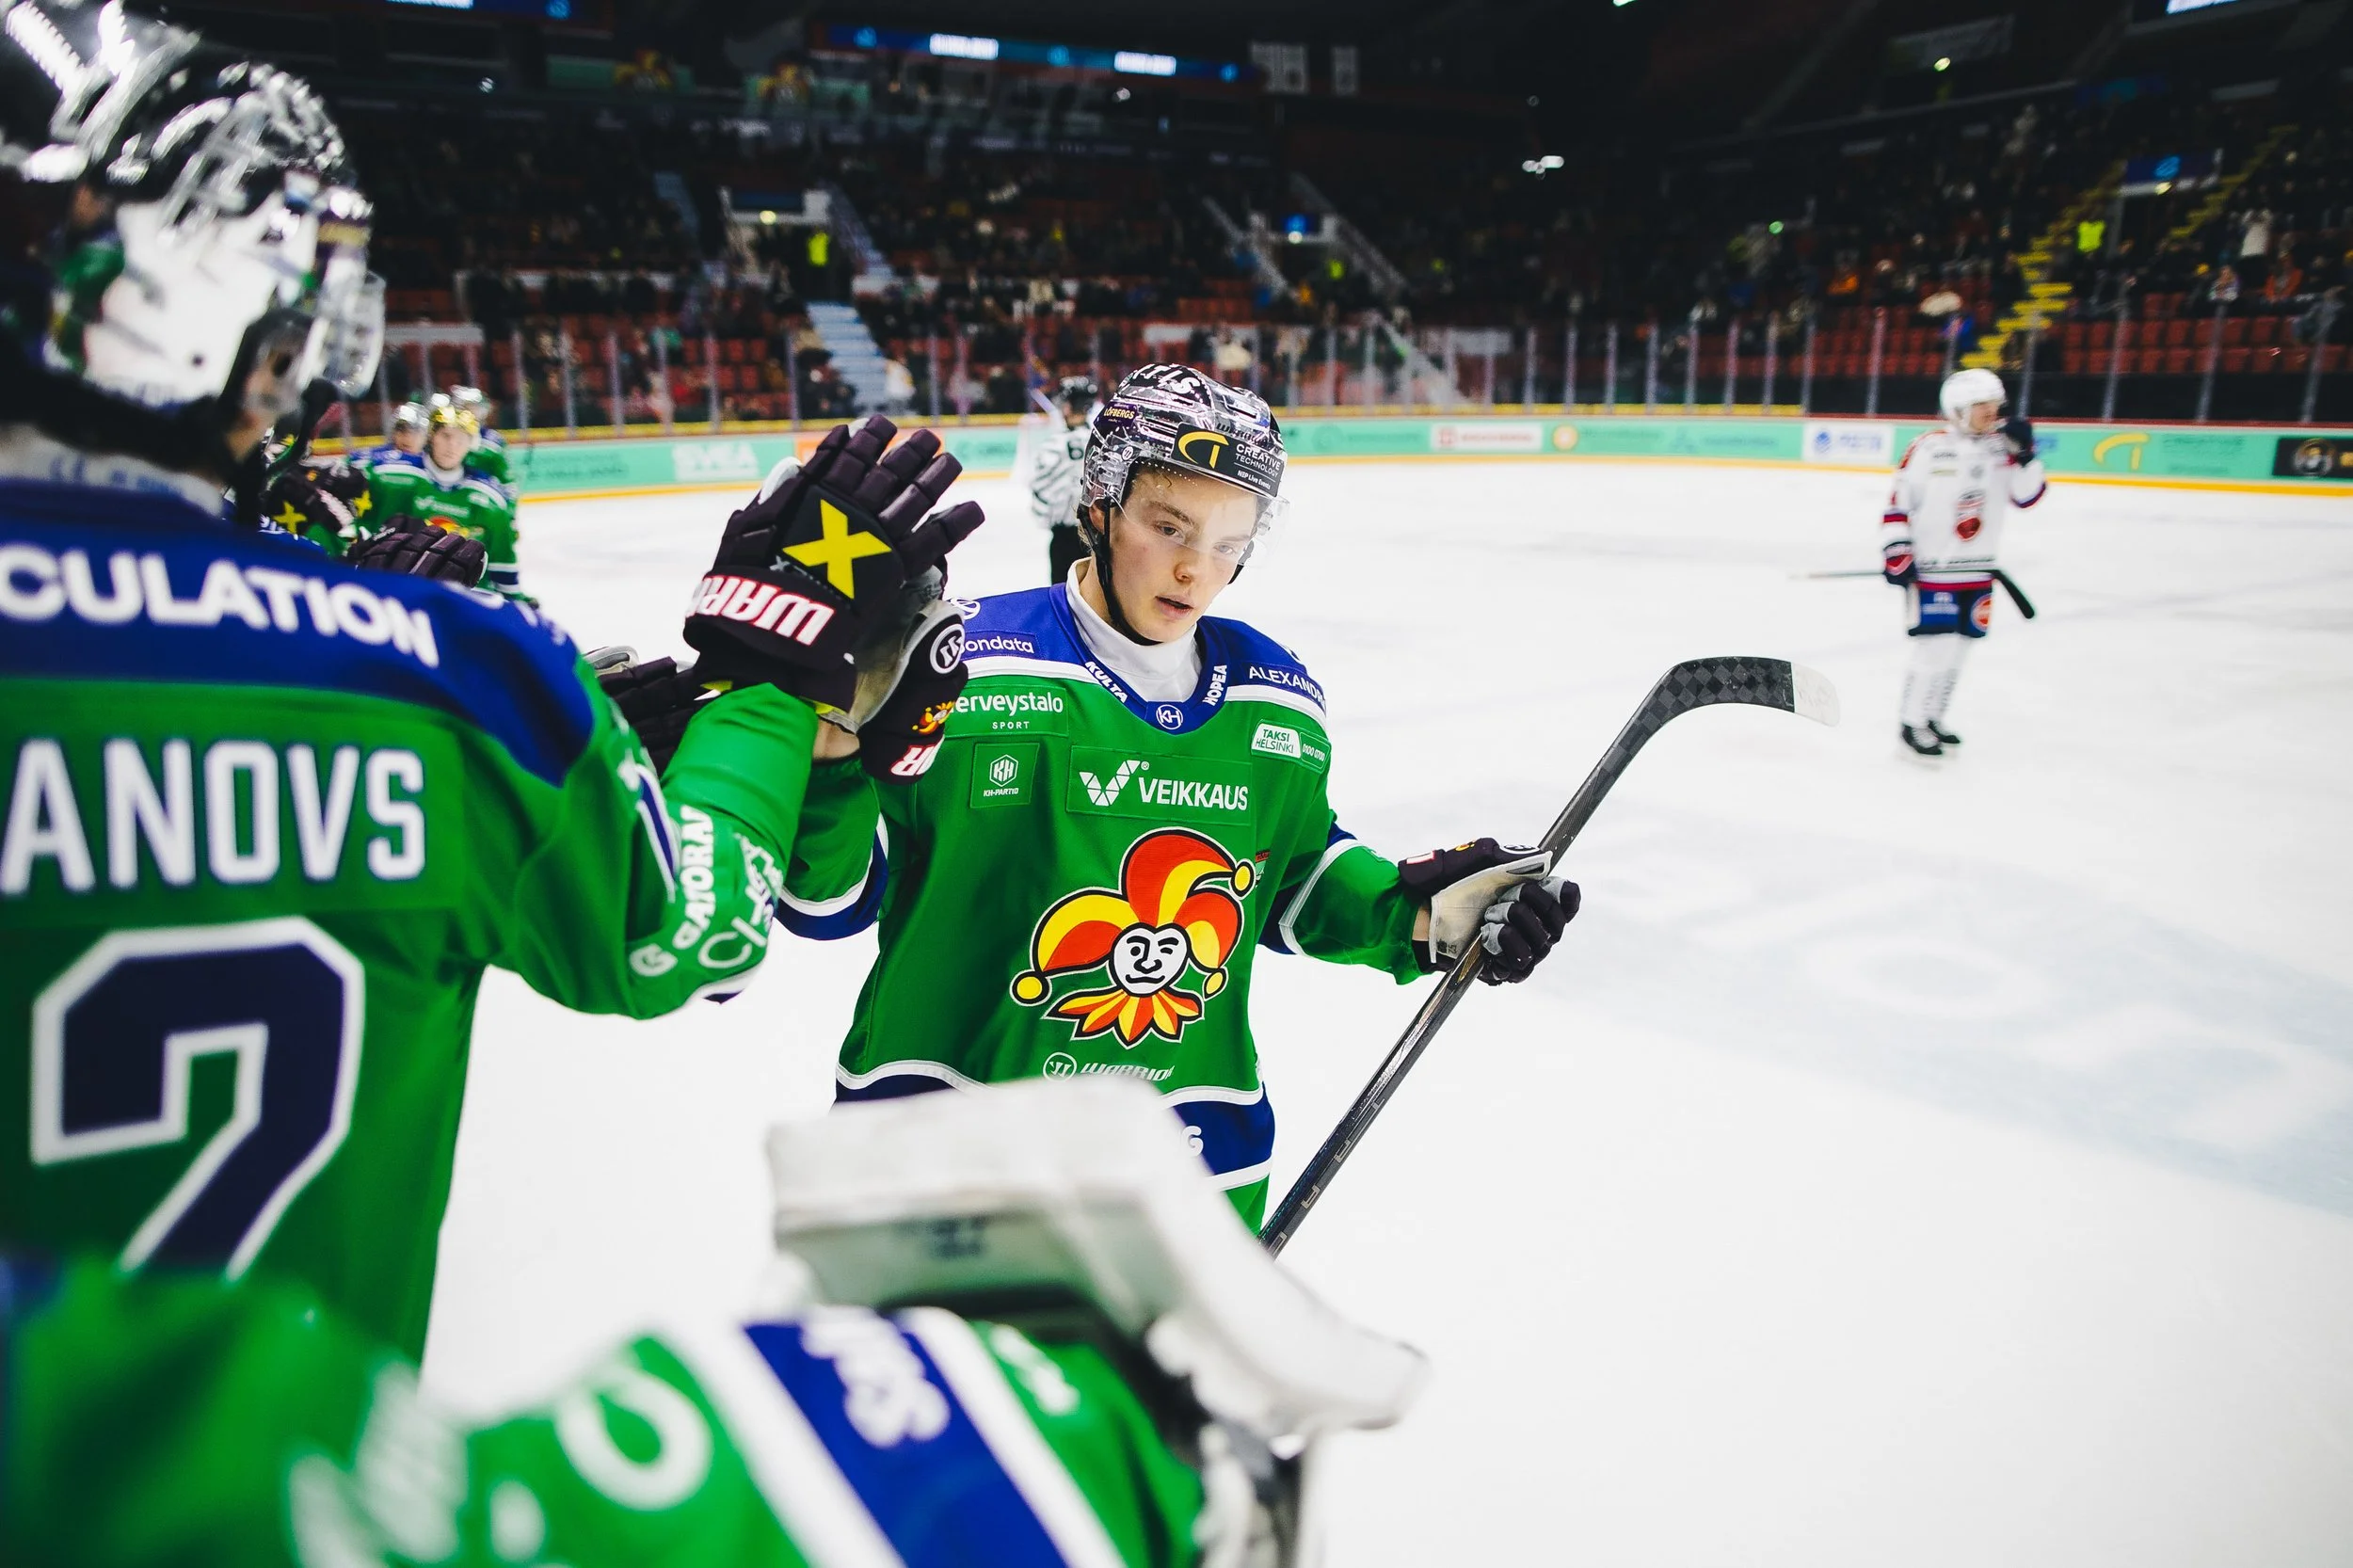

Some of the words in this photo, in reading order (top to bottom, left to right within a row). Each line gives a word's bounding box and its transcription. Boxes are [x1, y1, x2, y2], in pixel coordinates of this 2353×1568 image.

[1235, 453, 1278, 478] TECHNOLOGY
[1236, 443, 1281, 471] CREATIVE
[1238, 470, 1249, 478] NEP
[1248, 474, 1258, 484] Live
[0, 542, 440, 668] CULATION
[1084, 661, 1128, 704] KULTA
[1202, 664, 1227, 707] HOPEA
[951, 692, 1064, 716] erveystalo
[992, 721, 1030, 729] SPORT
[1263, 728, 1290, 743] TAKSI
[1255, 737, 1294, 754] HELSINKI
[992, 757, 1016, 784] KH
[1138, 776, 1249, 811] VEIKKAUS
[0, 737, 426, 896] ANOVS
